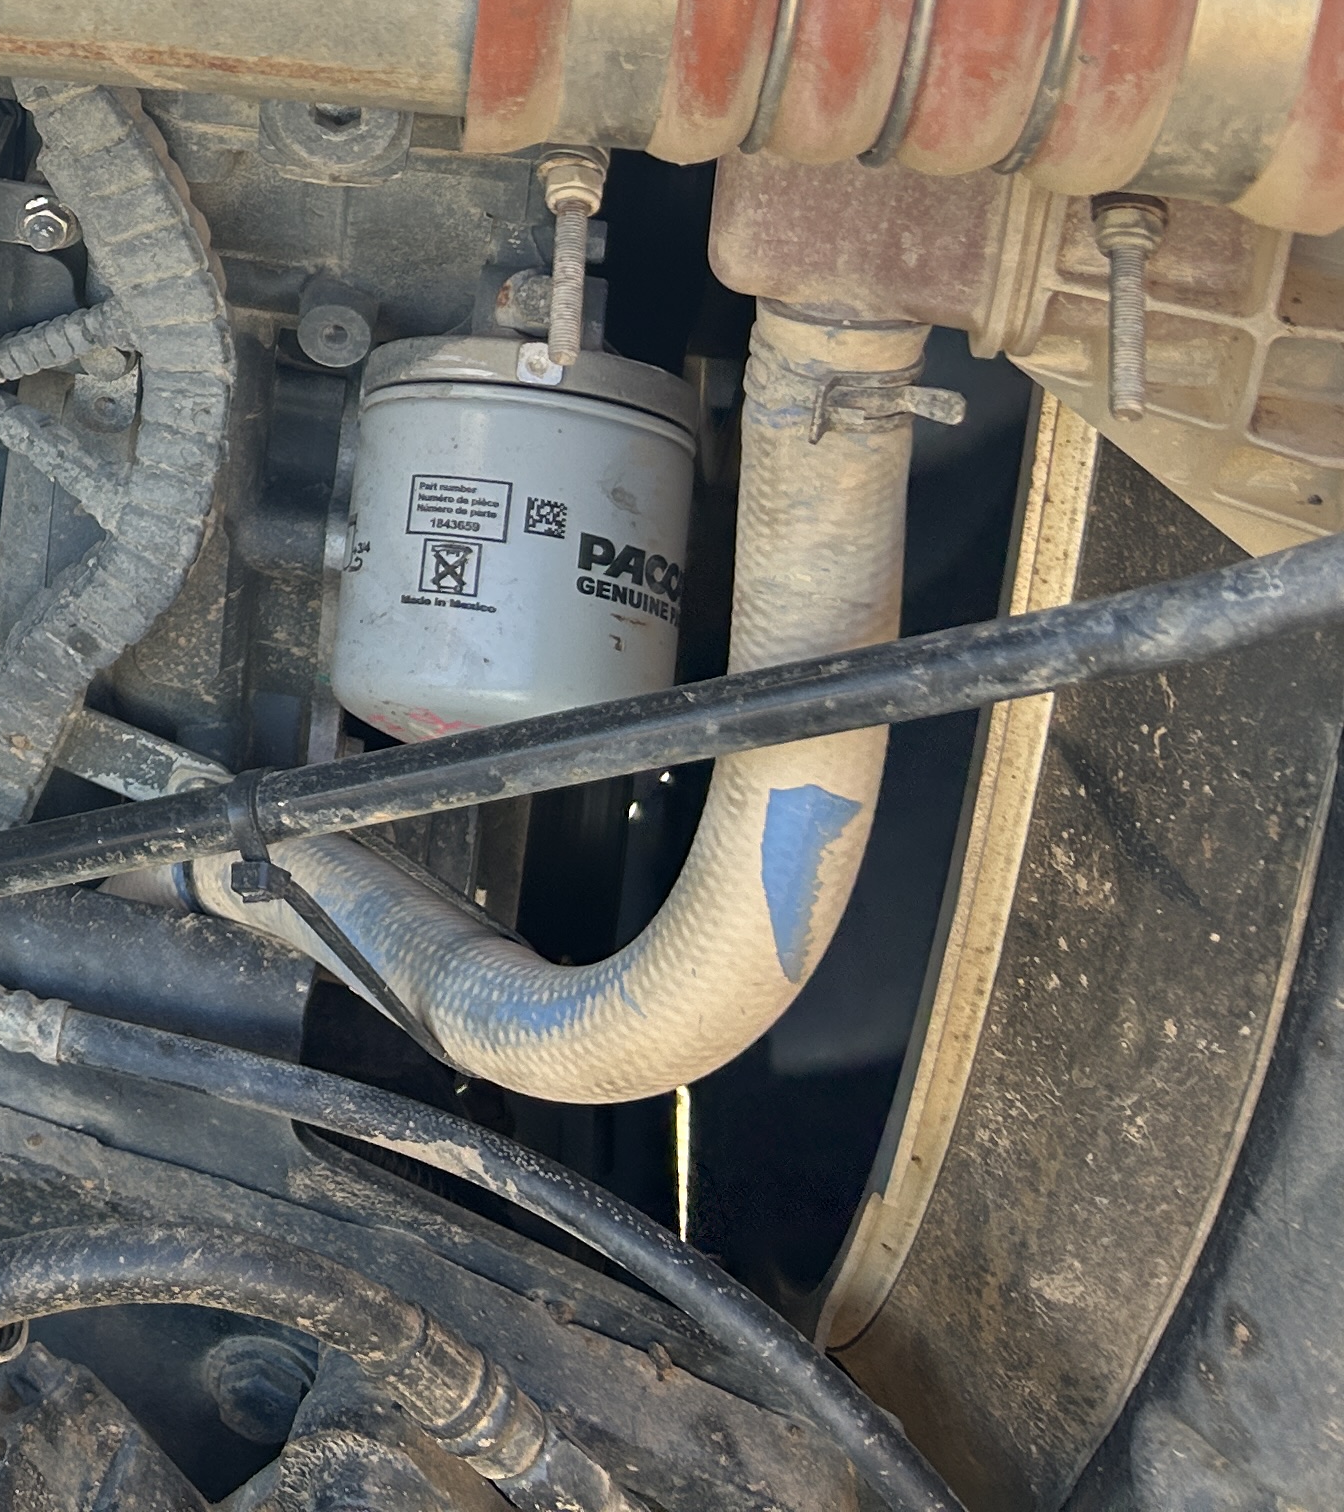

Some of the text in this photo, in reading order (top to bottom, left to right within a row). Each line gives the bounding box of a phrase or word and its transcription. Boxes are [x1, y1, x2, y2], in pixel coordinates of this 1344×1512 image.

[419, 482, 477, 493] Part number
[418, 493, 454, 503] Numéro
[456, 496, 469, 504] de
[417, 503, 497, 519] Número de parte
[578, 532, 683, 603] PACC
[401, 594, 497, 613] Made in Mexico
[576, 576, 669, 620] GENUINE
